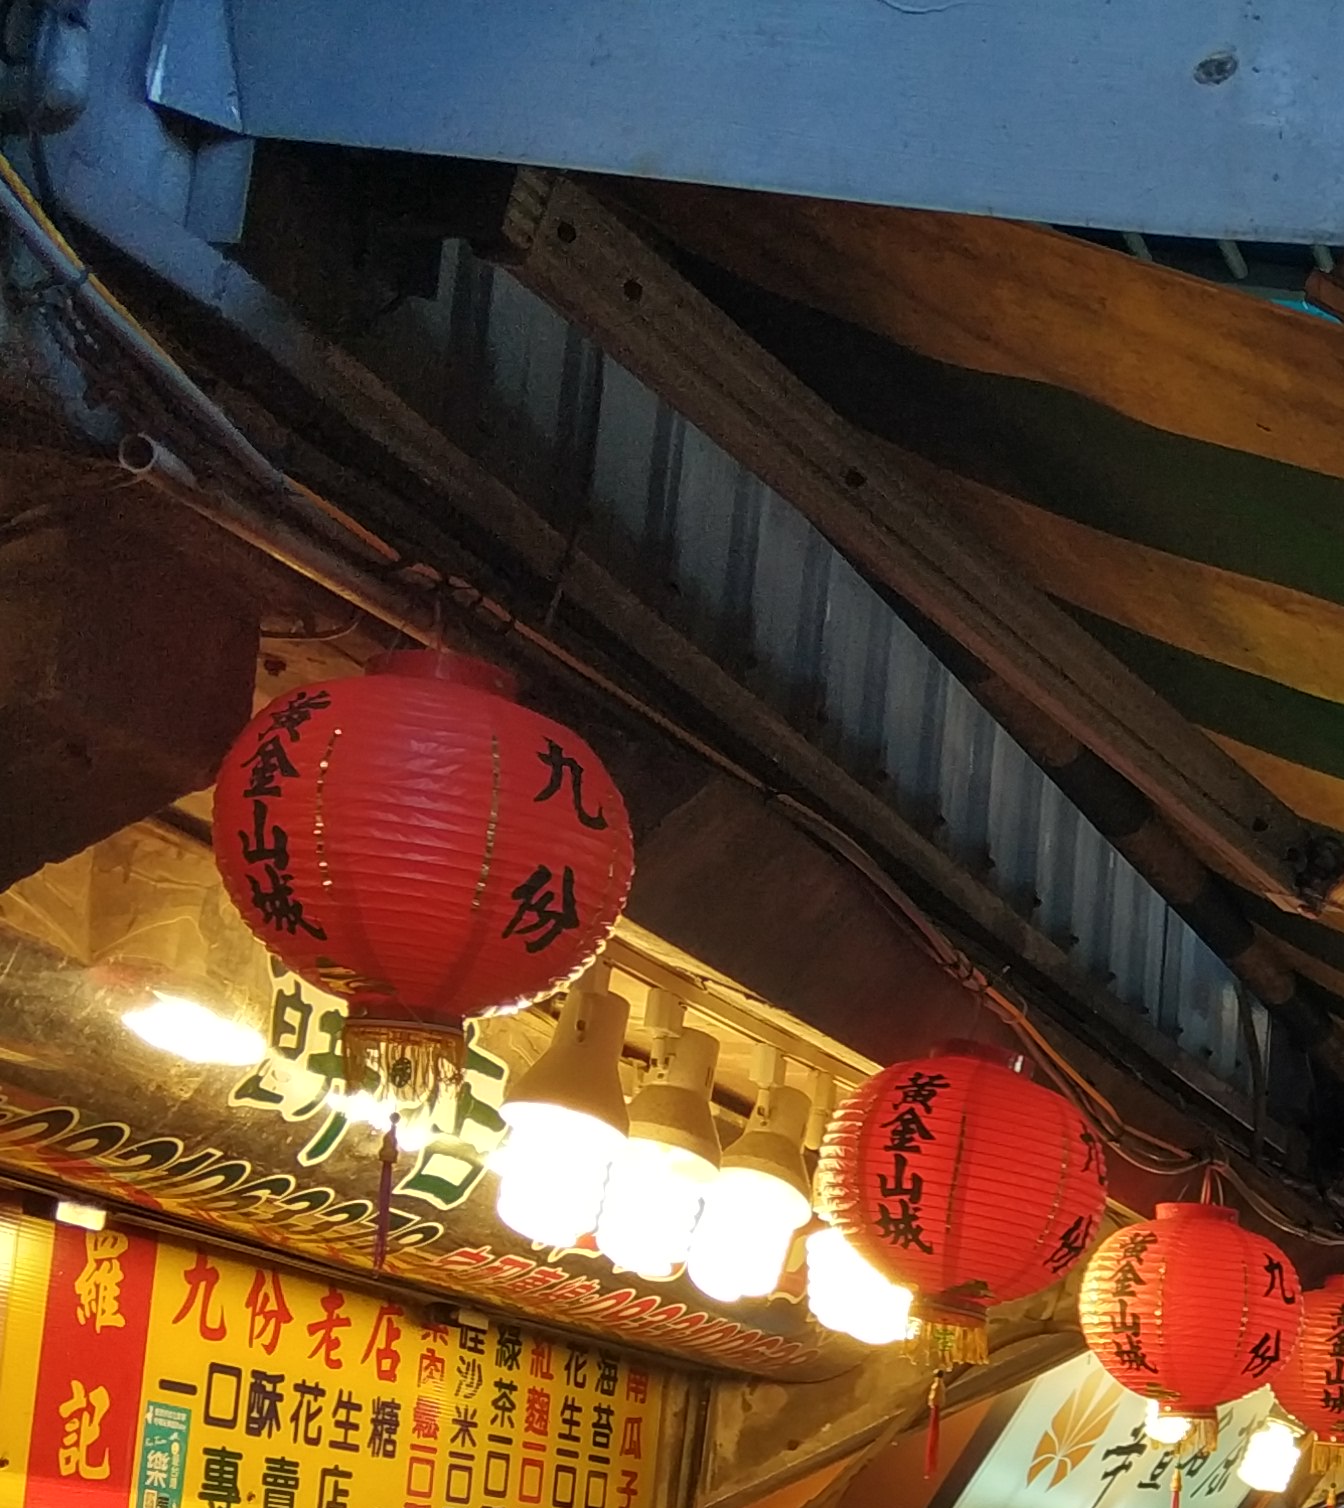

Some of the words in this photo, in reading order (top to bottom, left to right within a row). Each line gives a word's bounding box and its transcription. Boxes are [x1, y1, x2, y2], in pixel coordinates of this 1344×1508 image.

[171, 1253, 405, 1383] 九份老店
[157, 1360, 403, 1460] 一口酥花生糖
